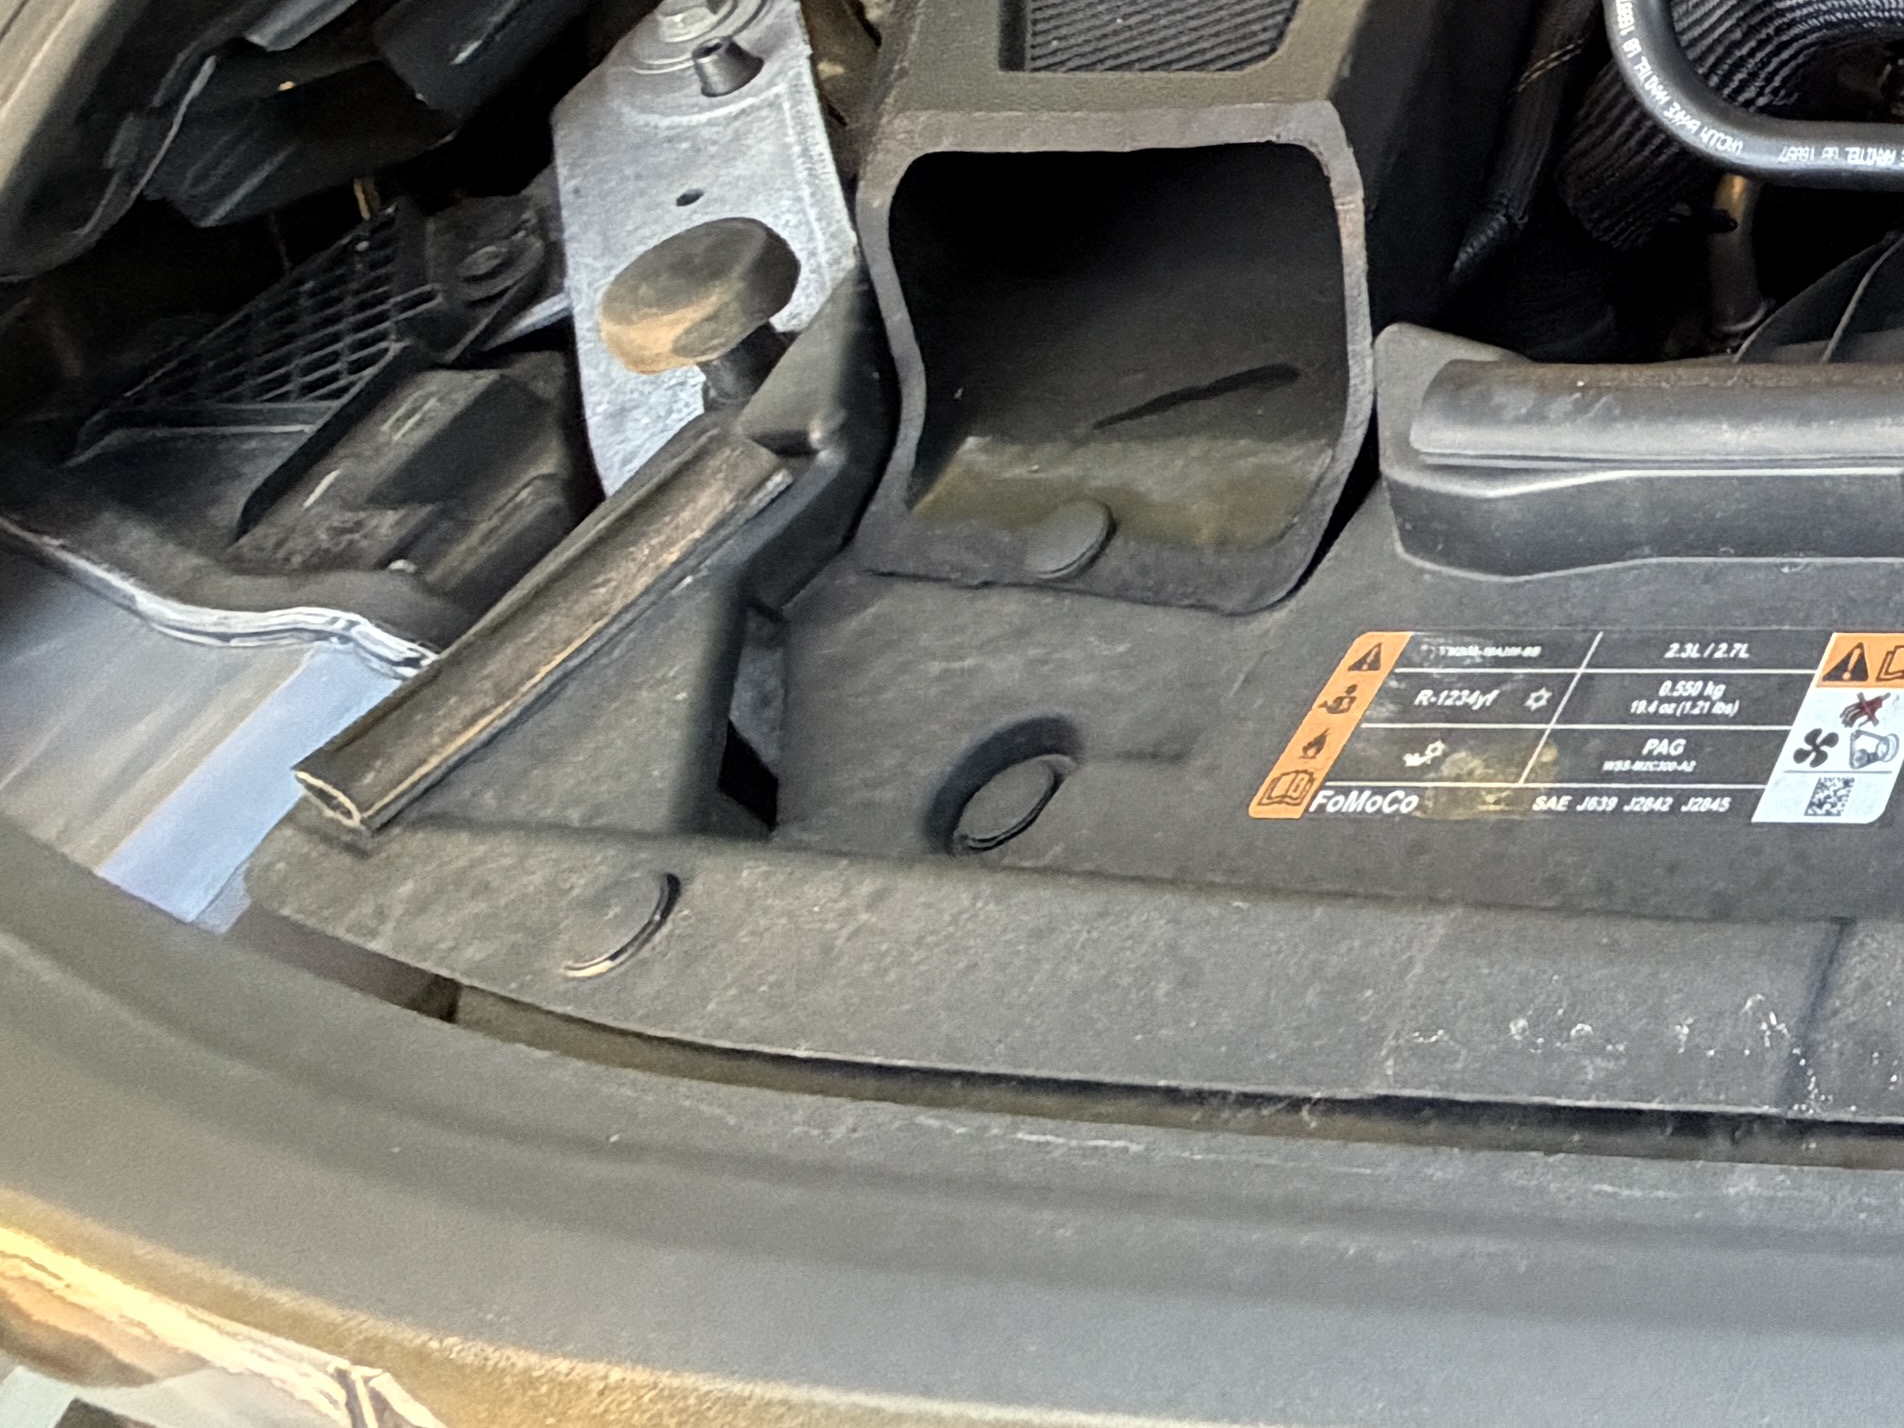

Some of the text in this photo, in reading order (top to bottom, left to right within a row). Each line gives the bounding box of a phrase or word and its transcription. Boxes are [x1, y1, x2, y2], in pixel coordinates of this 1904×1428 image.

[1663, 642, 1701, 659] 2.3L
[1712, 642, 1751, 659] 2.7L
[1413, 688, 1501, 711] R-1234yf
[1658, 680, 1727, 701] 0.550 kg
[1641, 738, 1687, 756] PAG
[1308, 789, 1731, 815] FoMoCo SAE J639 J2842 J2845
